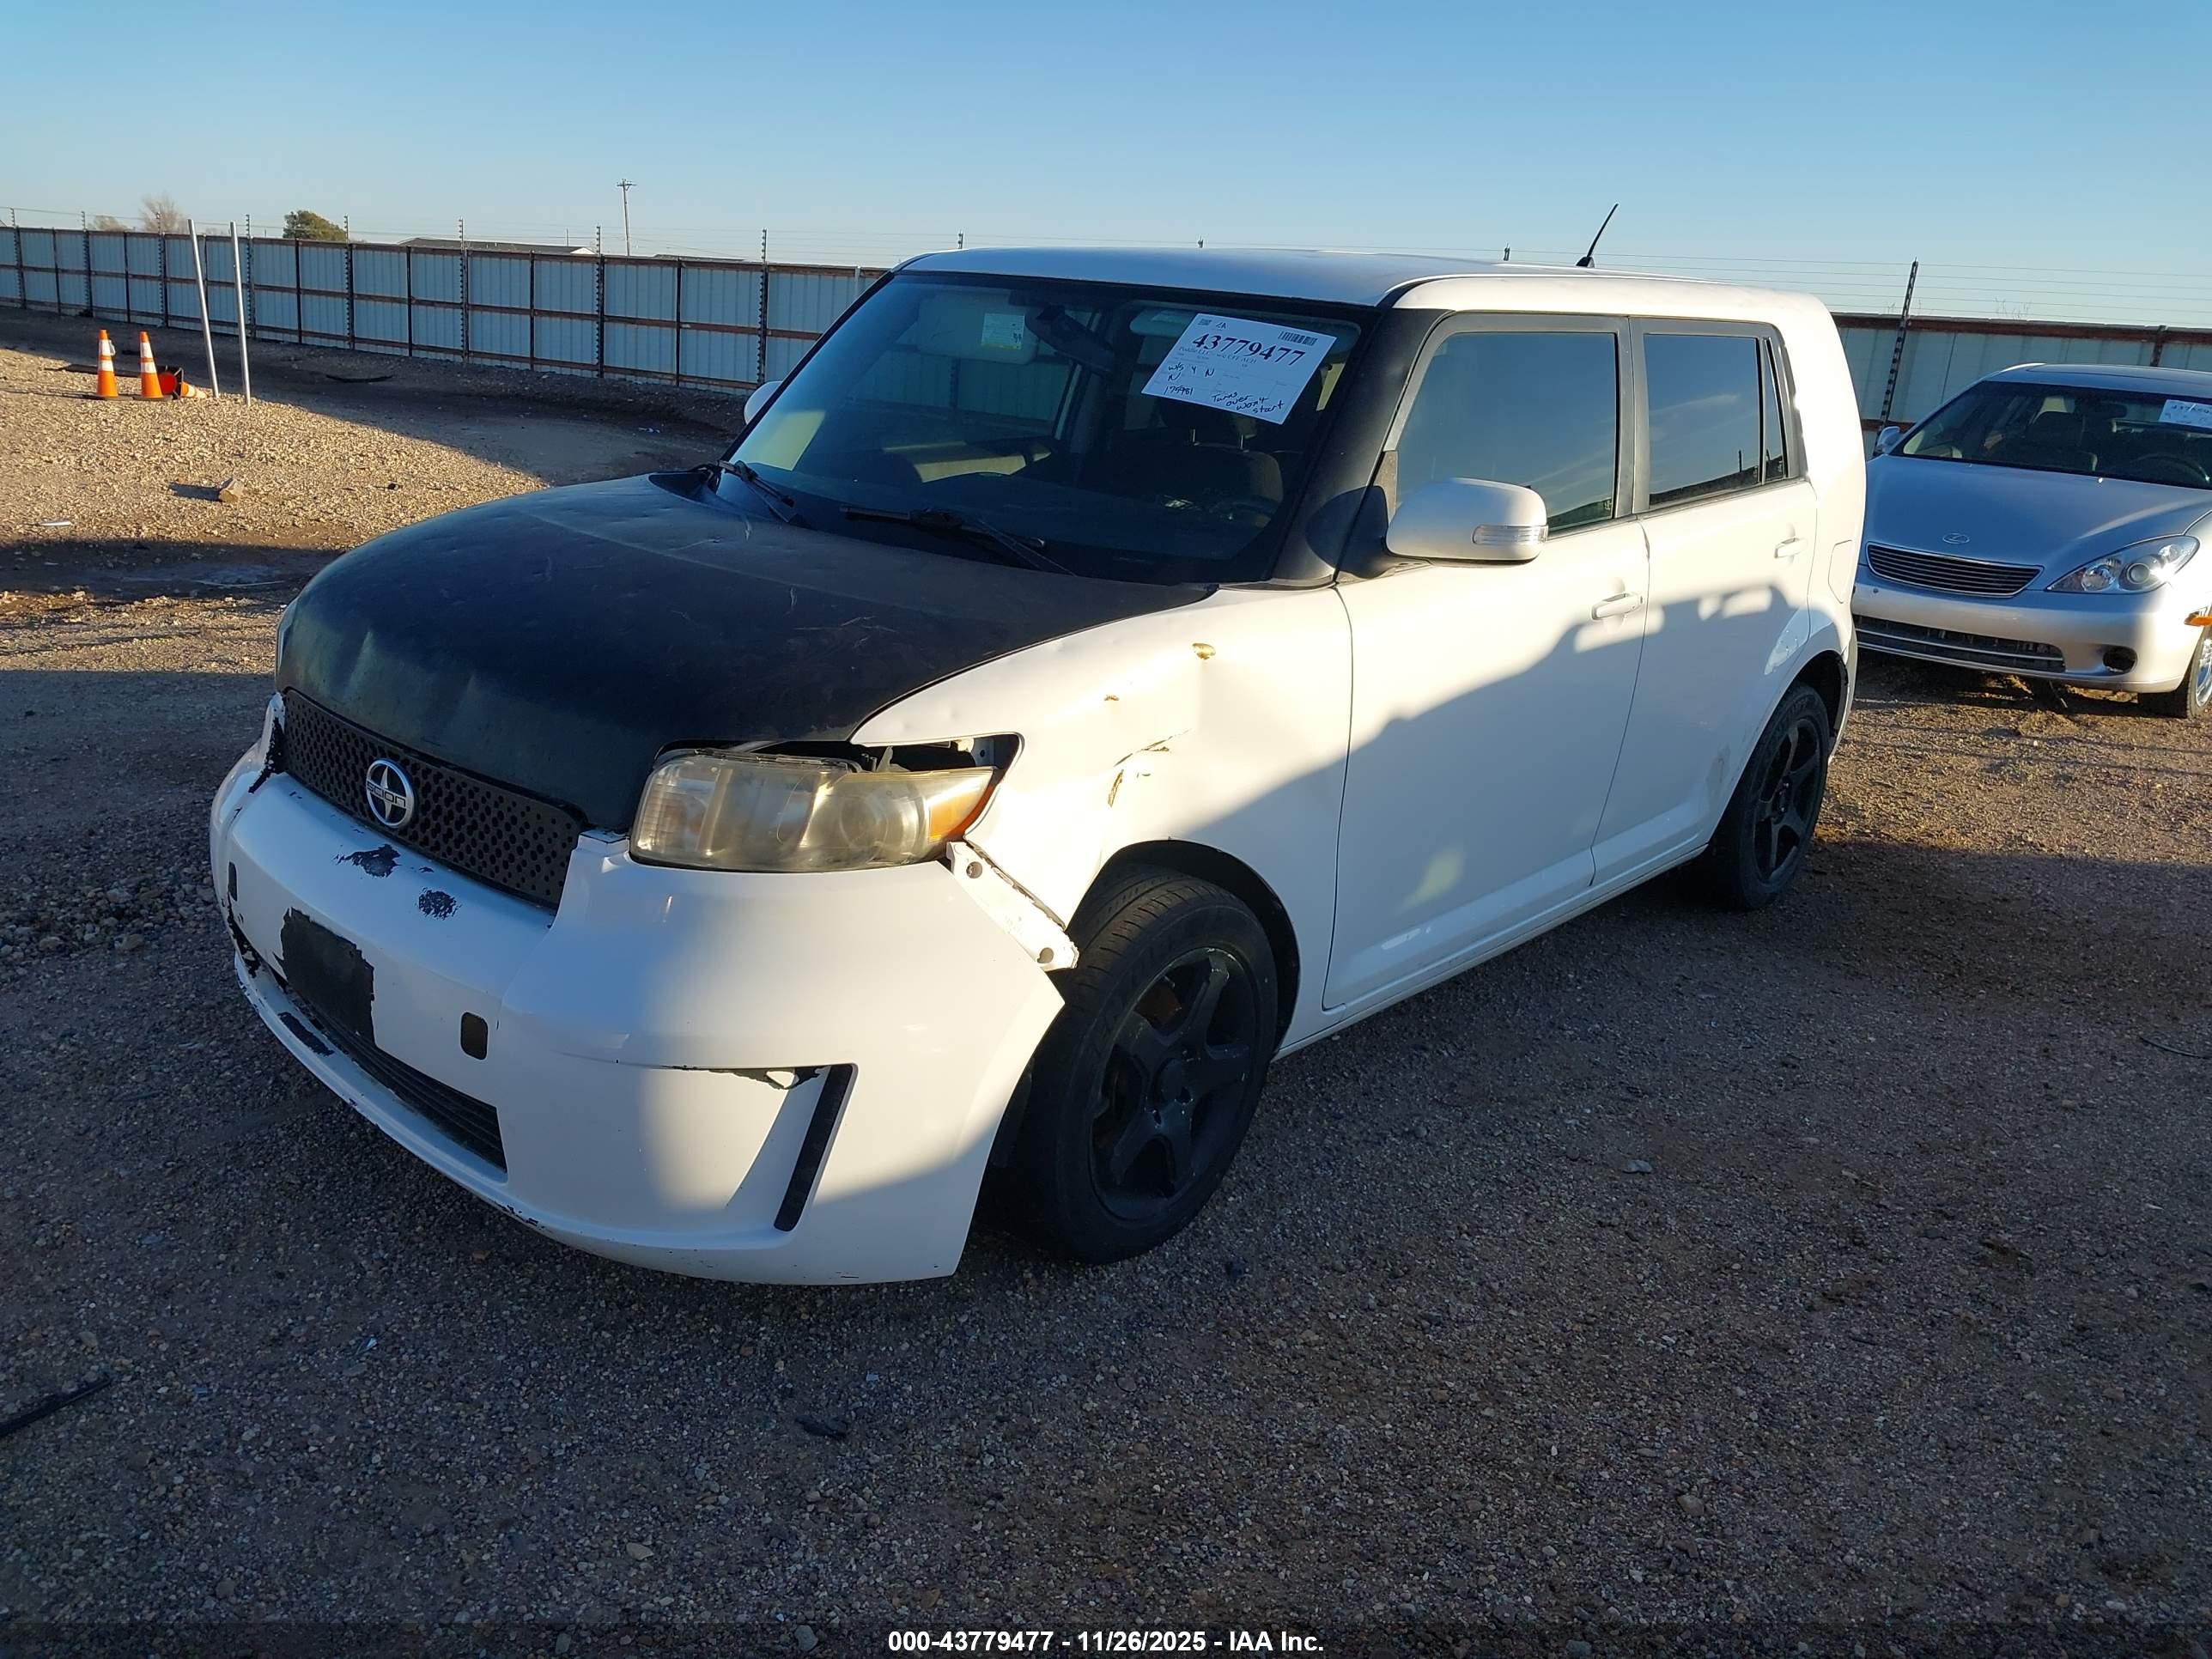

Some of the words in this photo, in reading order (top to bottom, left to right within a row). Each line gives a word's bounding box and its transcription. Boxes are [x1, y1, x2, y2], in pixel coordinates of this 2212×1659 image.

[1192, 332, 1305, 366] 43779477
[1205, 368, 1215, 377] N
[1253, 399, 1285, 414] start
